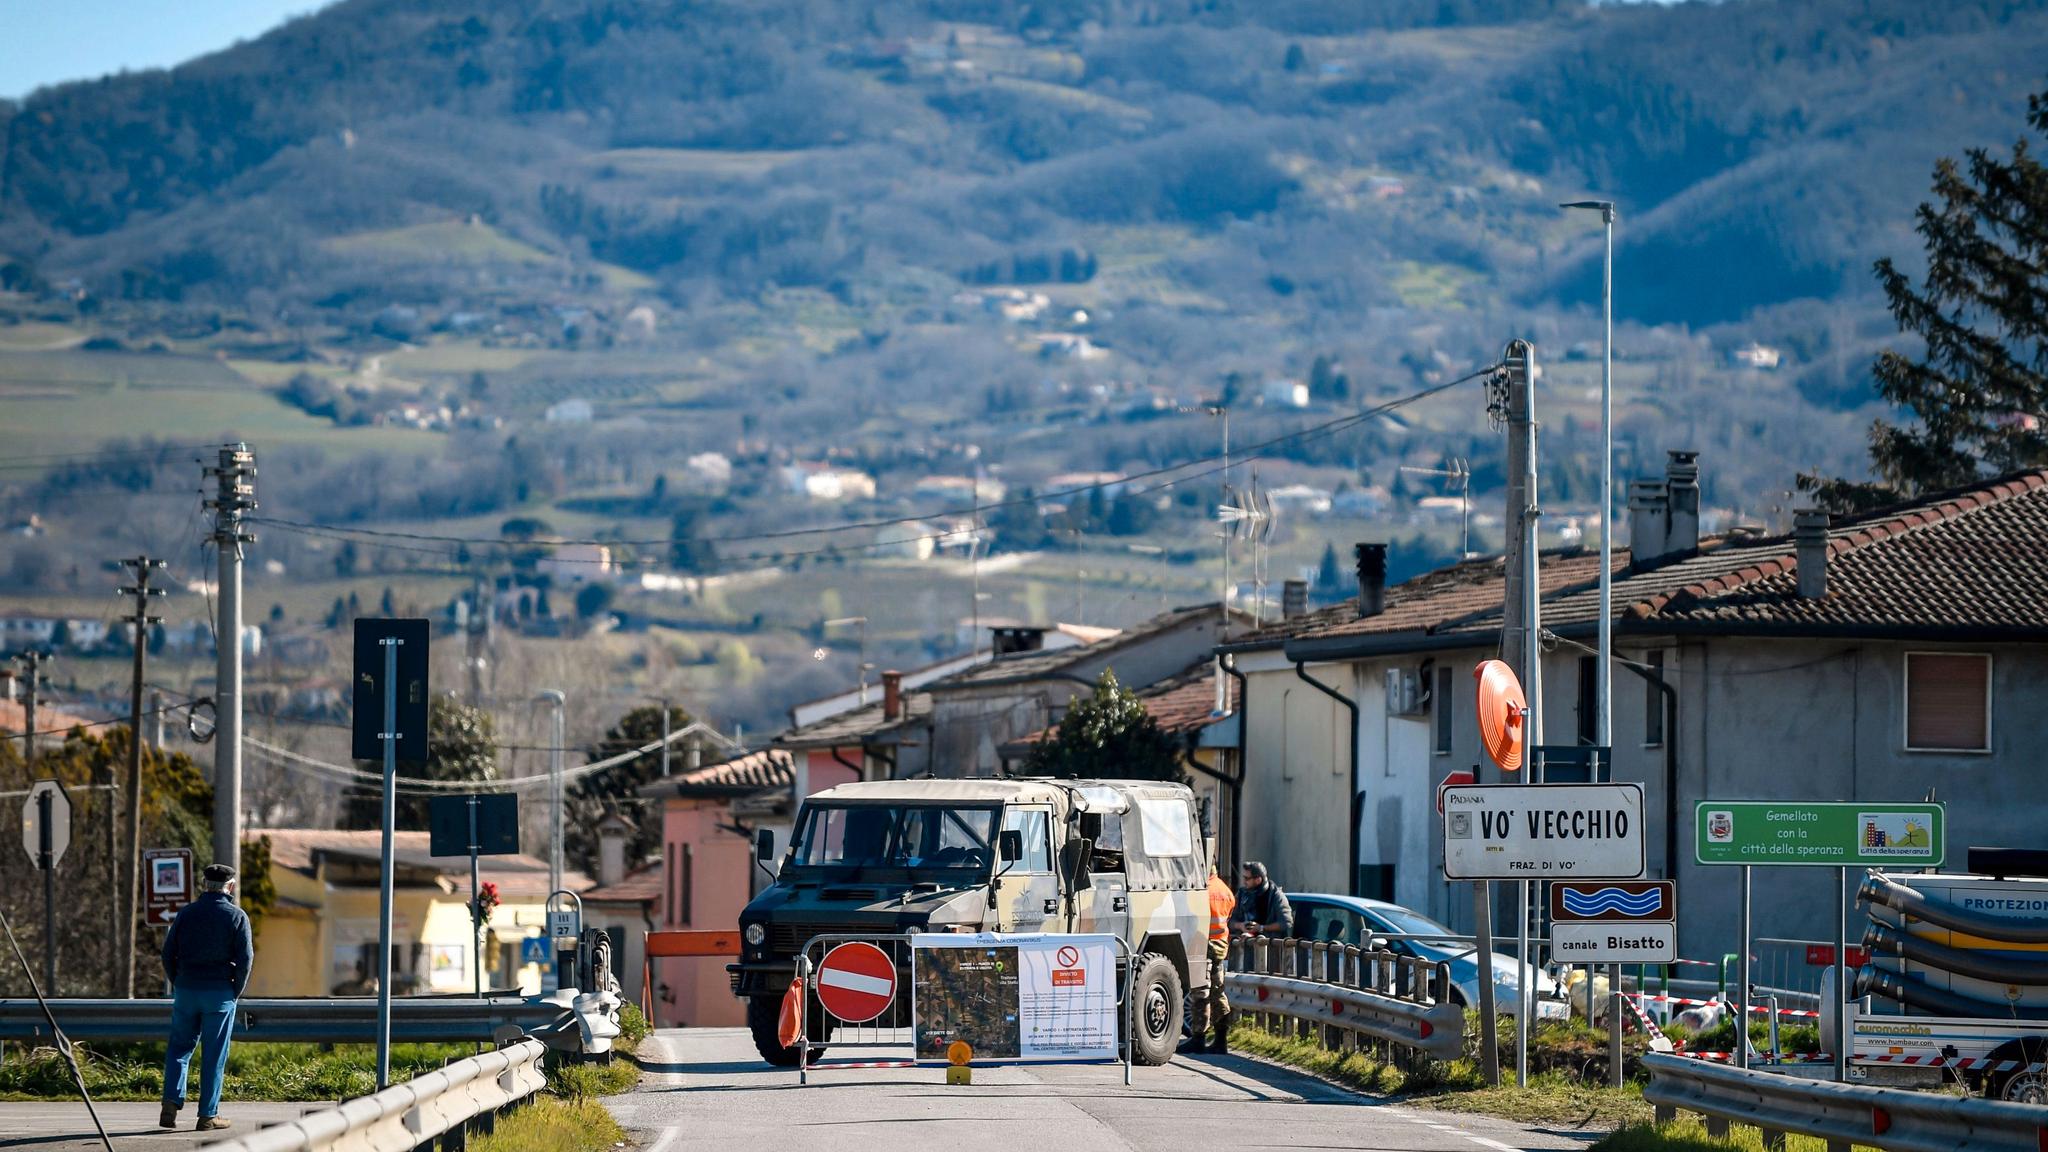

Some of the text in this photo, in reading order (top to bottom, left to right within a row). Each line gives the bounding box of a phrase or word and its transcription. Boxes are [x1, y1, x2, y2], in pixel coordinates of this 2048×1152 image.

[1766, 810, 1818, 822] Gemellato
[1527, 809, 1629, 840] VECCHIO
[1777, 827, 1808, 839] con la
[1741, 843, 1767, 855] città
[1769, 843, 1793, 855] della
[1797, 844, 1844, 857] speranza
[1509, 861, 1537, 870] FRAZ.
[1542, 861, 1552, 870] DI
[557, 926, 570, 935] 27
[1562, 936, 1665, 951] canale Bisatto
[1867, 1038, 1934, 1047] www.humbaur.com
